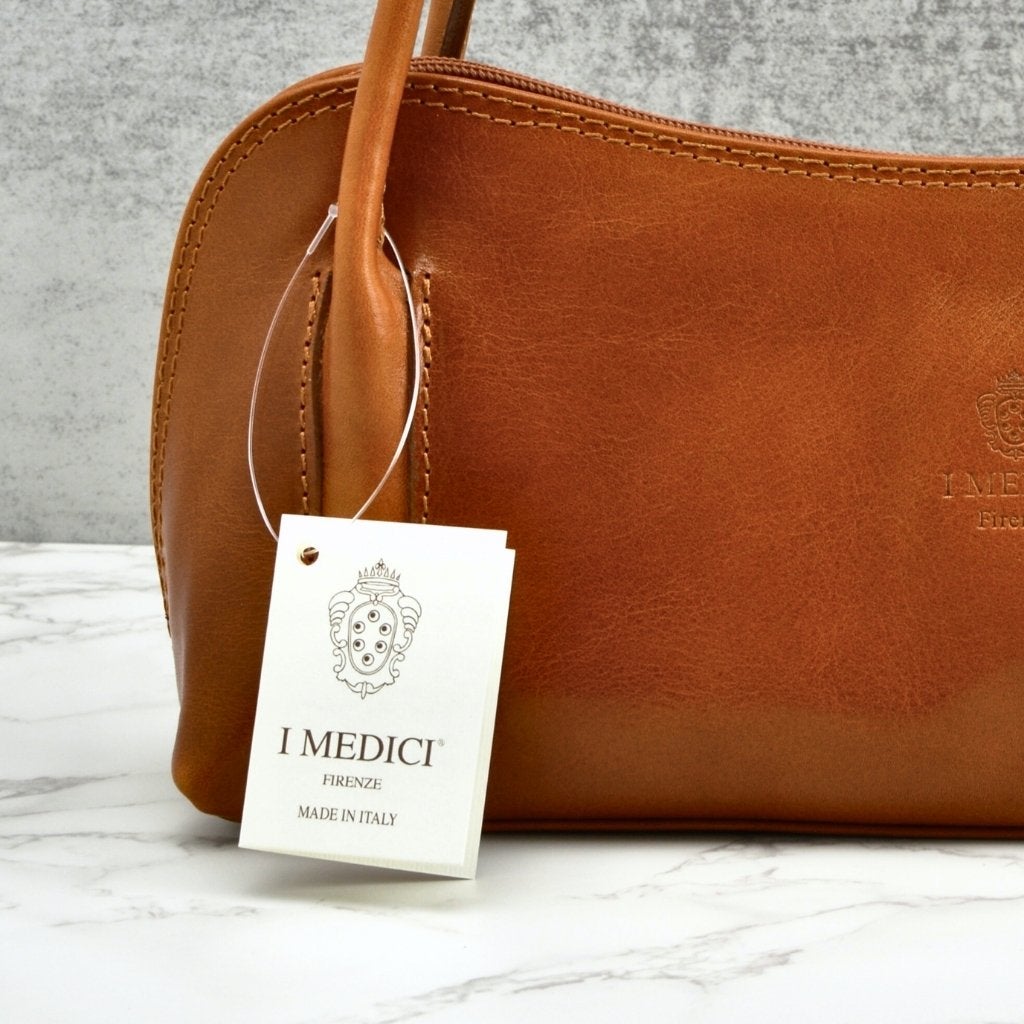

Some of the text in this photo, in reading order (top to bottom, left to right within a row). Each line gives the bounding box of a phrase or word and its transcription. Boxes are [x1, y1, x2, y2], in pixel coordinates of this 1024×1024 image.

[942, 471, 955, 499] I
[278, 727, 292, 755] I
[322, 773, 382, 790] FIRENZE
[297, 804, 398, 827] MADE IN ITALY
